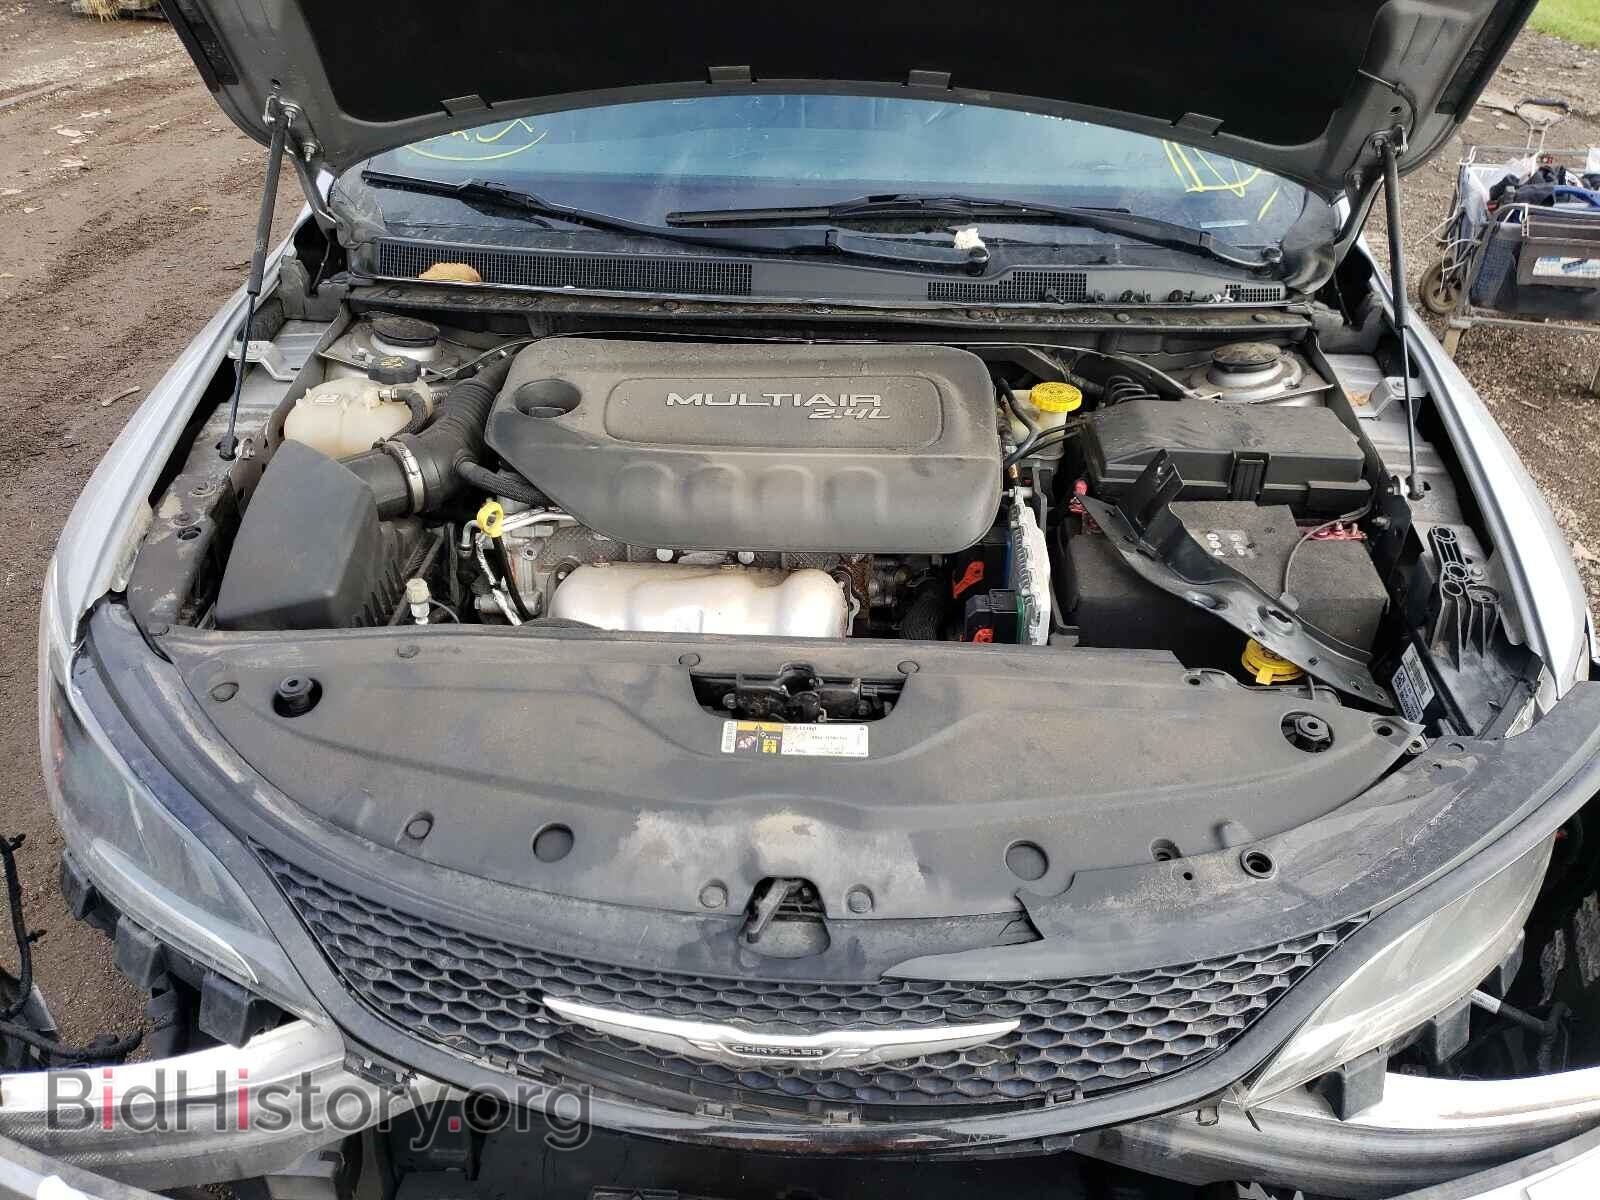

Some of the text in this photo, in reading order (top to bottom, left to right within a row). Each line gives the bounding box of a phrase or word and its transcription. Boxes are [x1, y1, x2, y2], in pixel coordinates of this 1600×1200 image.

[666, 392, 882, 407] MULTIAIR
[808, 408, 891, 420] 2.4L
[732, 1045, 824, 1057] CHRYSLER
